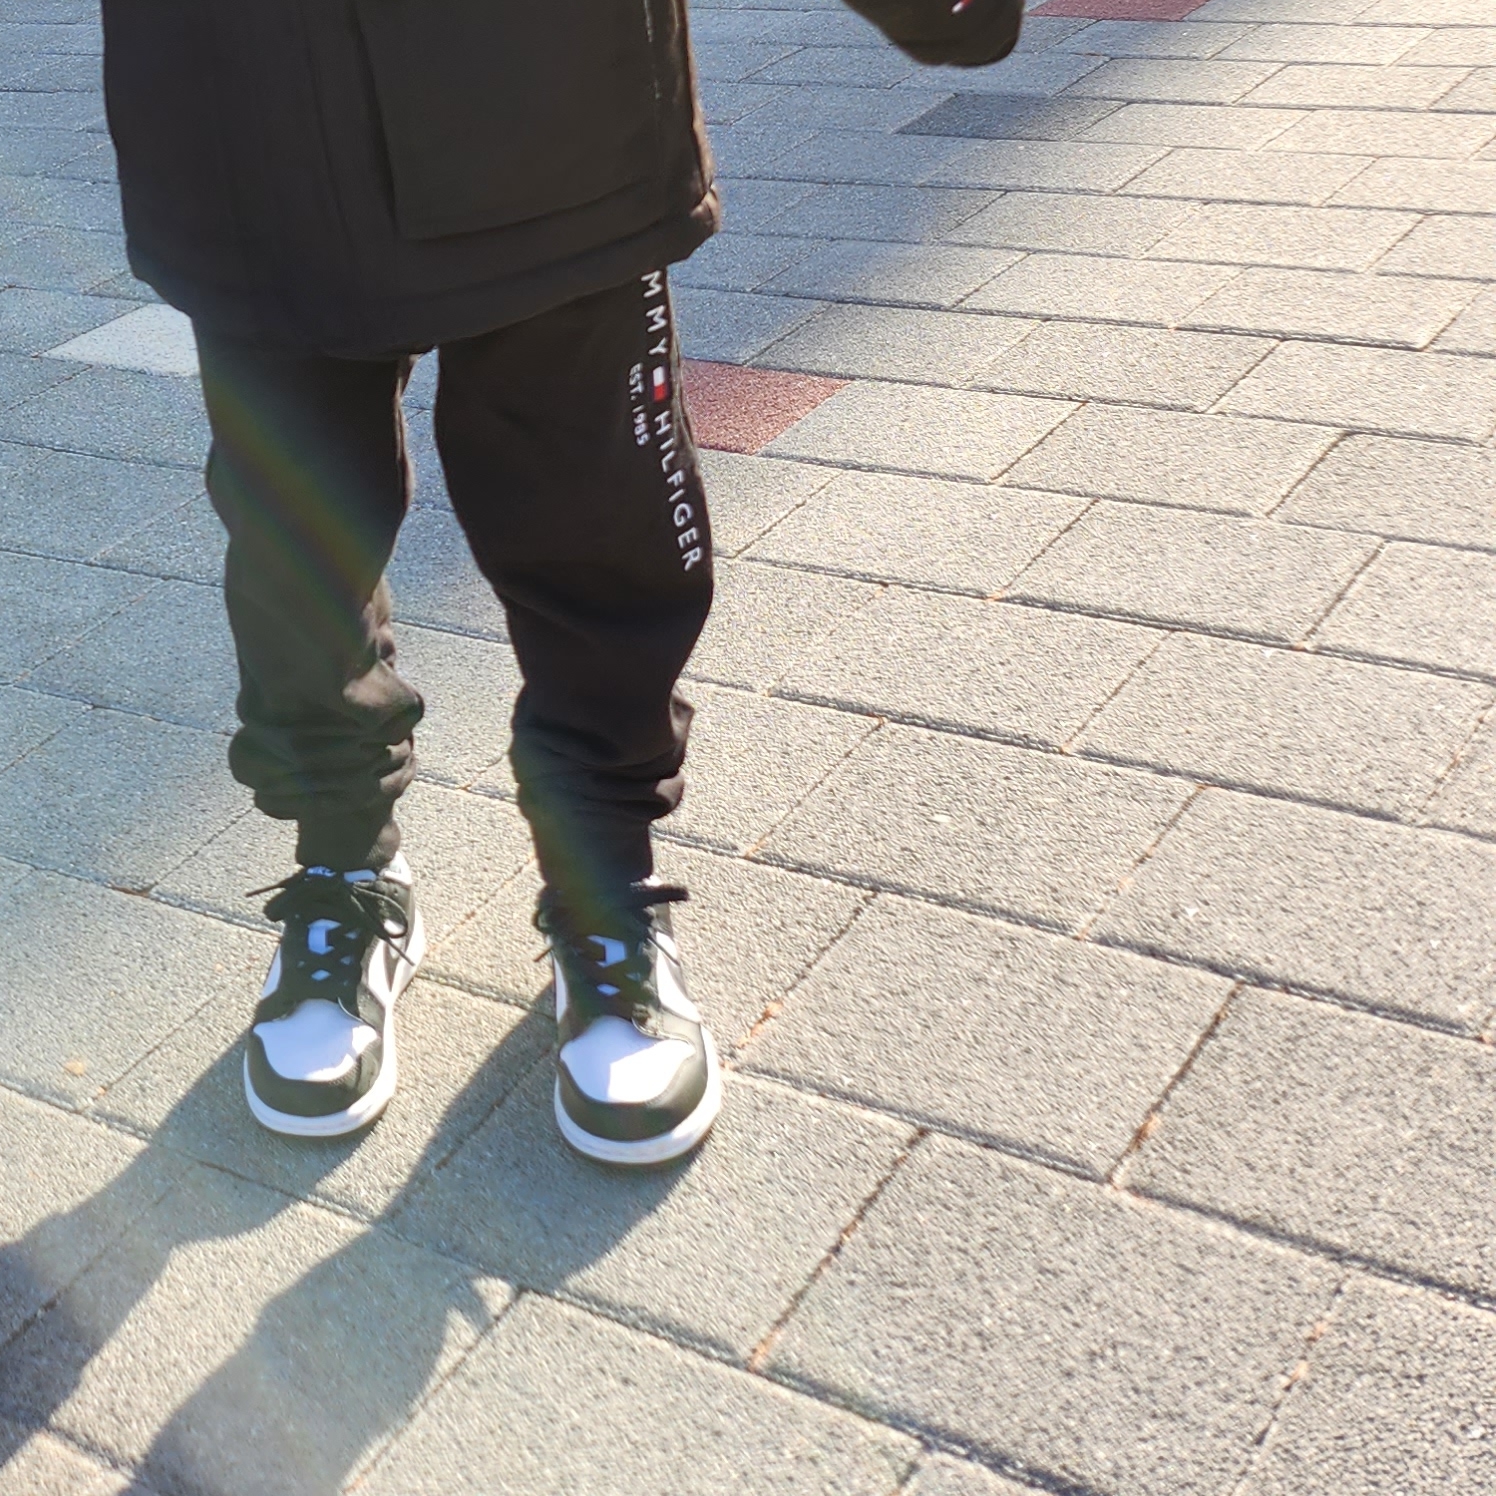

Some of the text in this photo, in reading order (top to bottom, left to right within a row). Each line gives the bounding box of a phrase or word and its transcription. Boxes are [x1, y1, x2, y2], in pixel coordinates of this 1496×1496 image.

[629, 362, 651, 446] EST. 1985
[654, 409, 703, 572] HILFIGER
